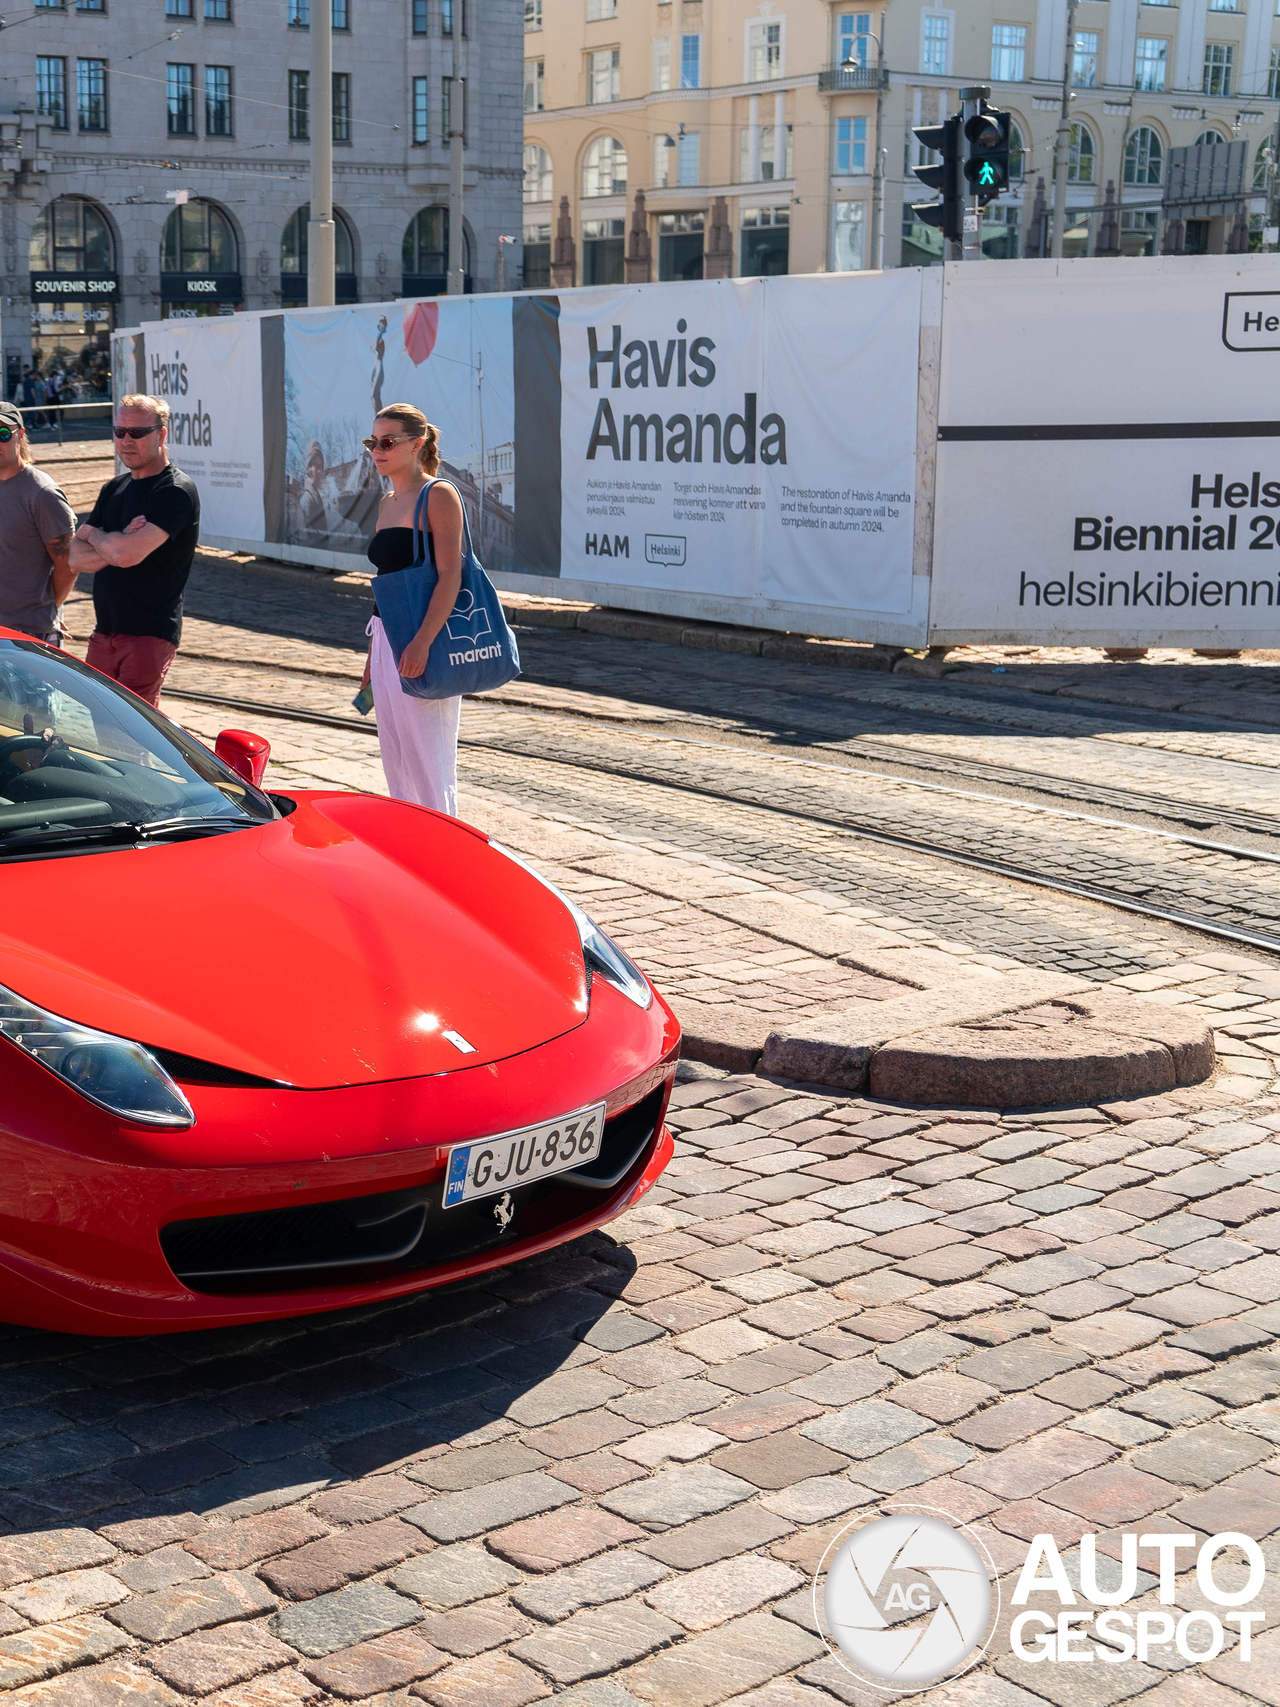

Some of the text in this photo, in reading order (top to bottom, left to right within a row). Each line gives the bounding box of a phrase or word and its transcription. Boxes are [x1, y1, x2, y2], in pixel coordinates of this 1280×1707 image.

[35, 281, 116, 293] SOUVENIR SHOP
[187, 281, 217, 293] KIOSK
[169, 309, 198, 319] KIOSK
[587, 318, 716, 389] Havis
[150, 350, 189, 396] Havis
[166, 399, 212, 447] manda
[586, 392, 788, 465] Amanda
[613, 480, 631, 490] Havis
[631, 481, 662, 491] Amandan
[693, 483, 707, 493] och
[708, 484, 725, 494] Havis
[1191, 472, 1280, 508] Hels
[782, 486, 911, 503] The restoration of Havis Amanda
[735, 500, 747, 509] att
[780, 501, 899, 518] and the fountain square will be
[684, 510, 708, 521] hösten
[781, 516, 885, 533] completed in autumn 2024.
[1073, 515, 1238, 551] Biennial
[585, 533, 630, 558] HAM
[650, 543, 681, 557] Helsinki
[1019, 571, 1280, 607] helsinkibienni
[448, 641, 502, 666] marant
[473, 1115, 597, 1188] GJU-836
[448, 1180, 465, 1195] FIN
